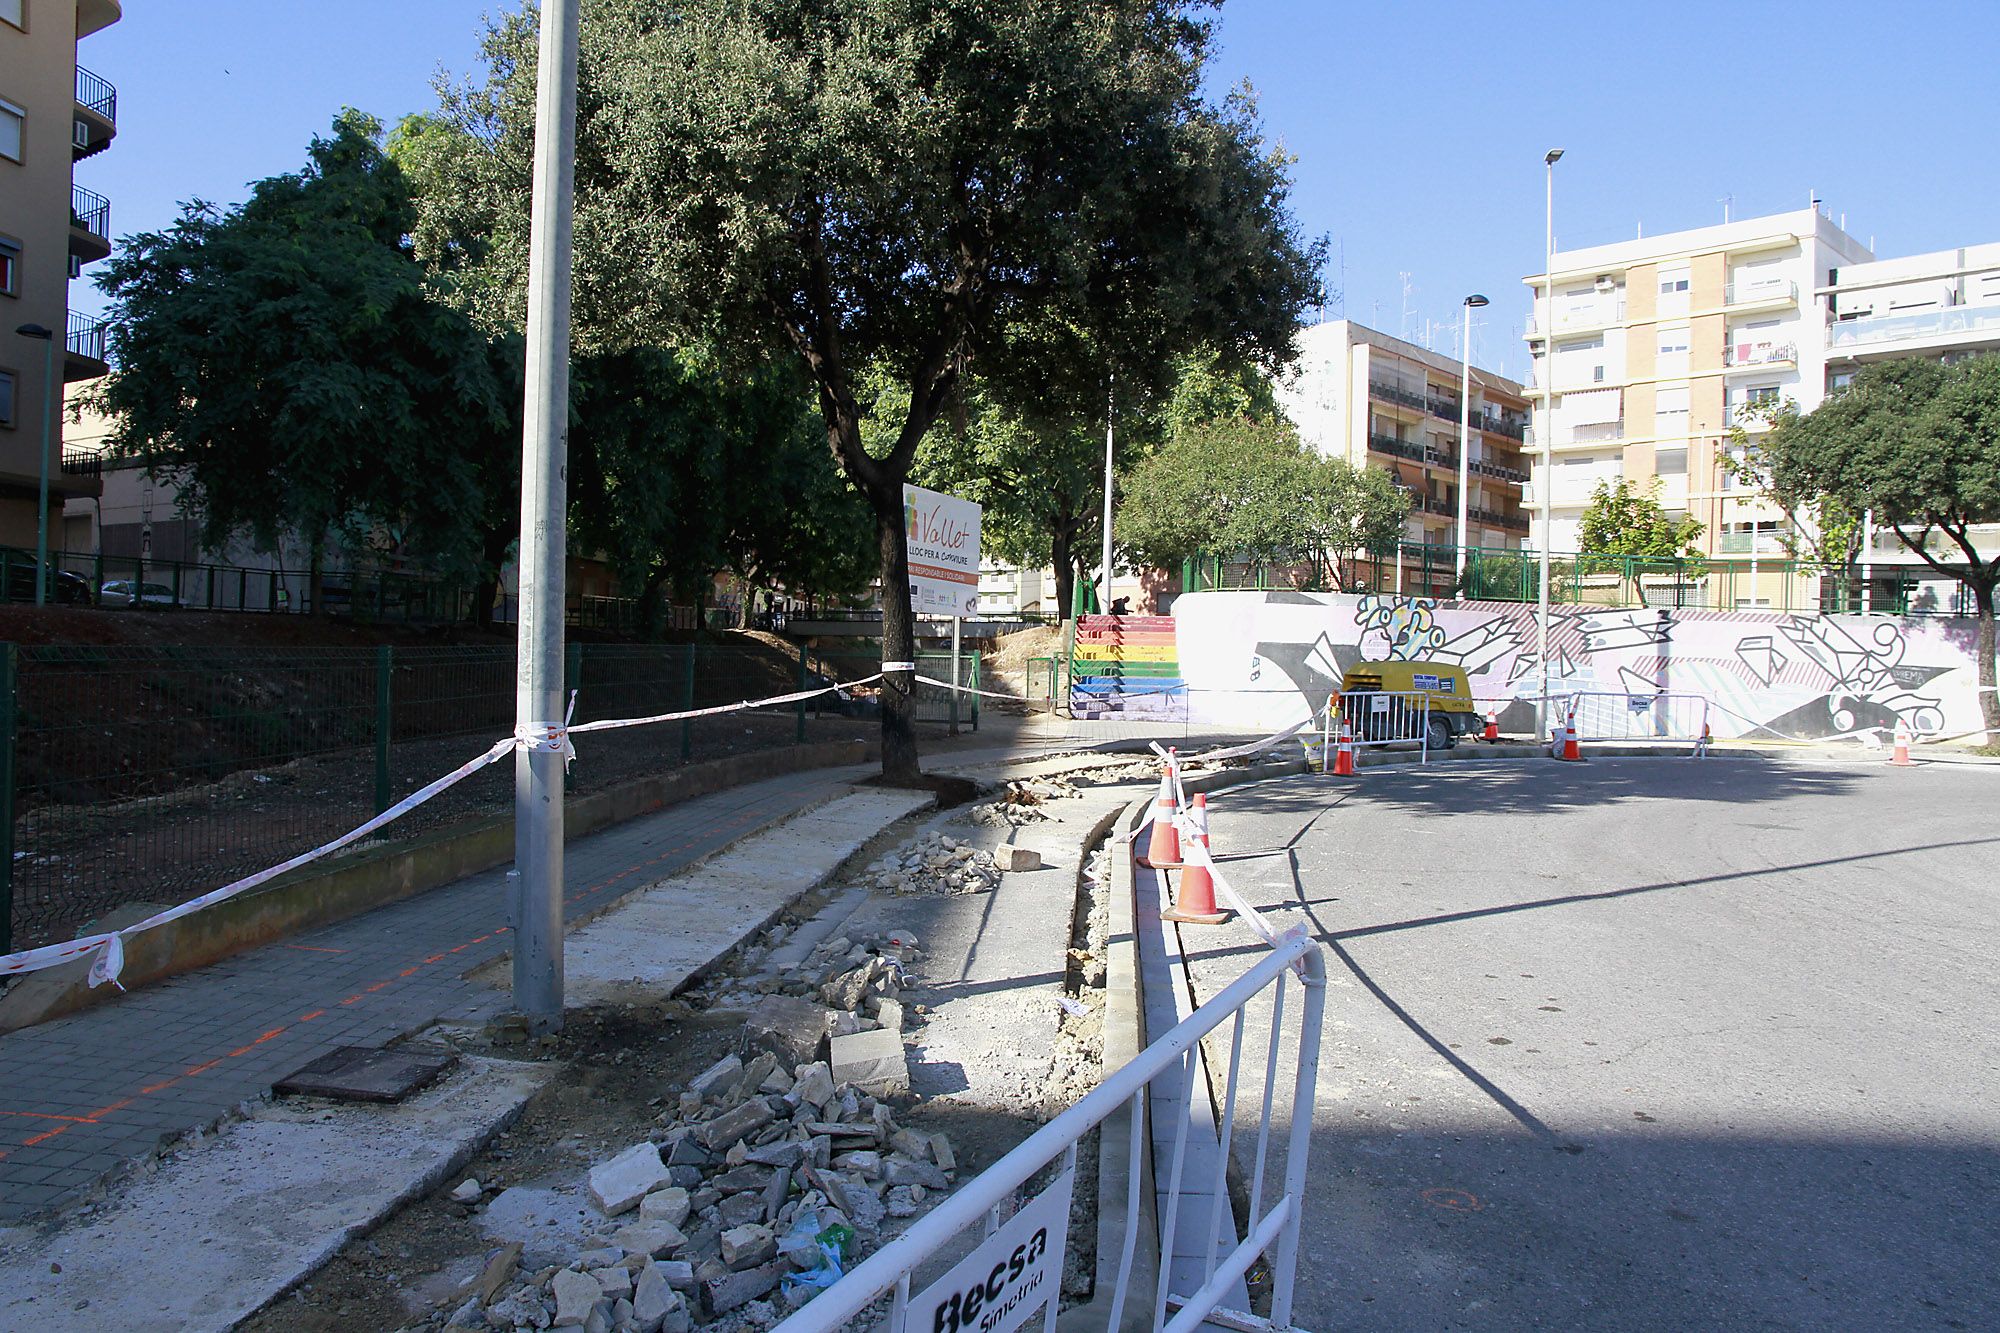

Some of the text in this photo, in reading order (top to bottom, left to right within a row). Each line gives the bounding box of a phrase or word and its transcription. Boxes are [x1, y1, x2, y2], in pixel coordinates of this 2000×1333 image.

[922, 504, 969, 549] Vallet
[909, 545, 924, 557] LLOC
[924, 549, 935, 559] PER
[935, 551, 940, 560] A
[934, 1227, 1047, 1333] Becsa
